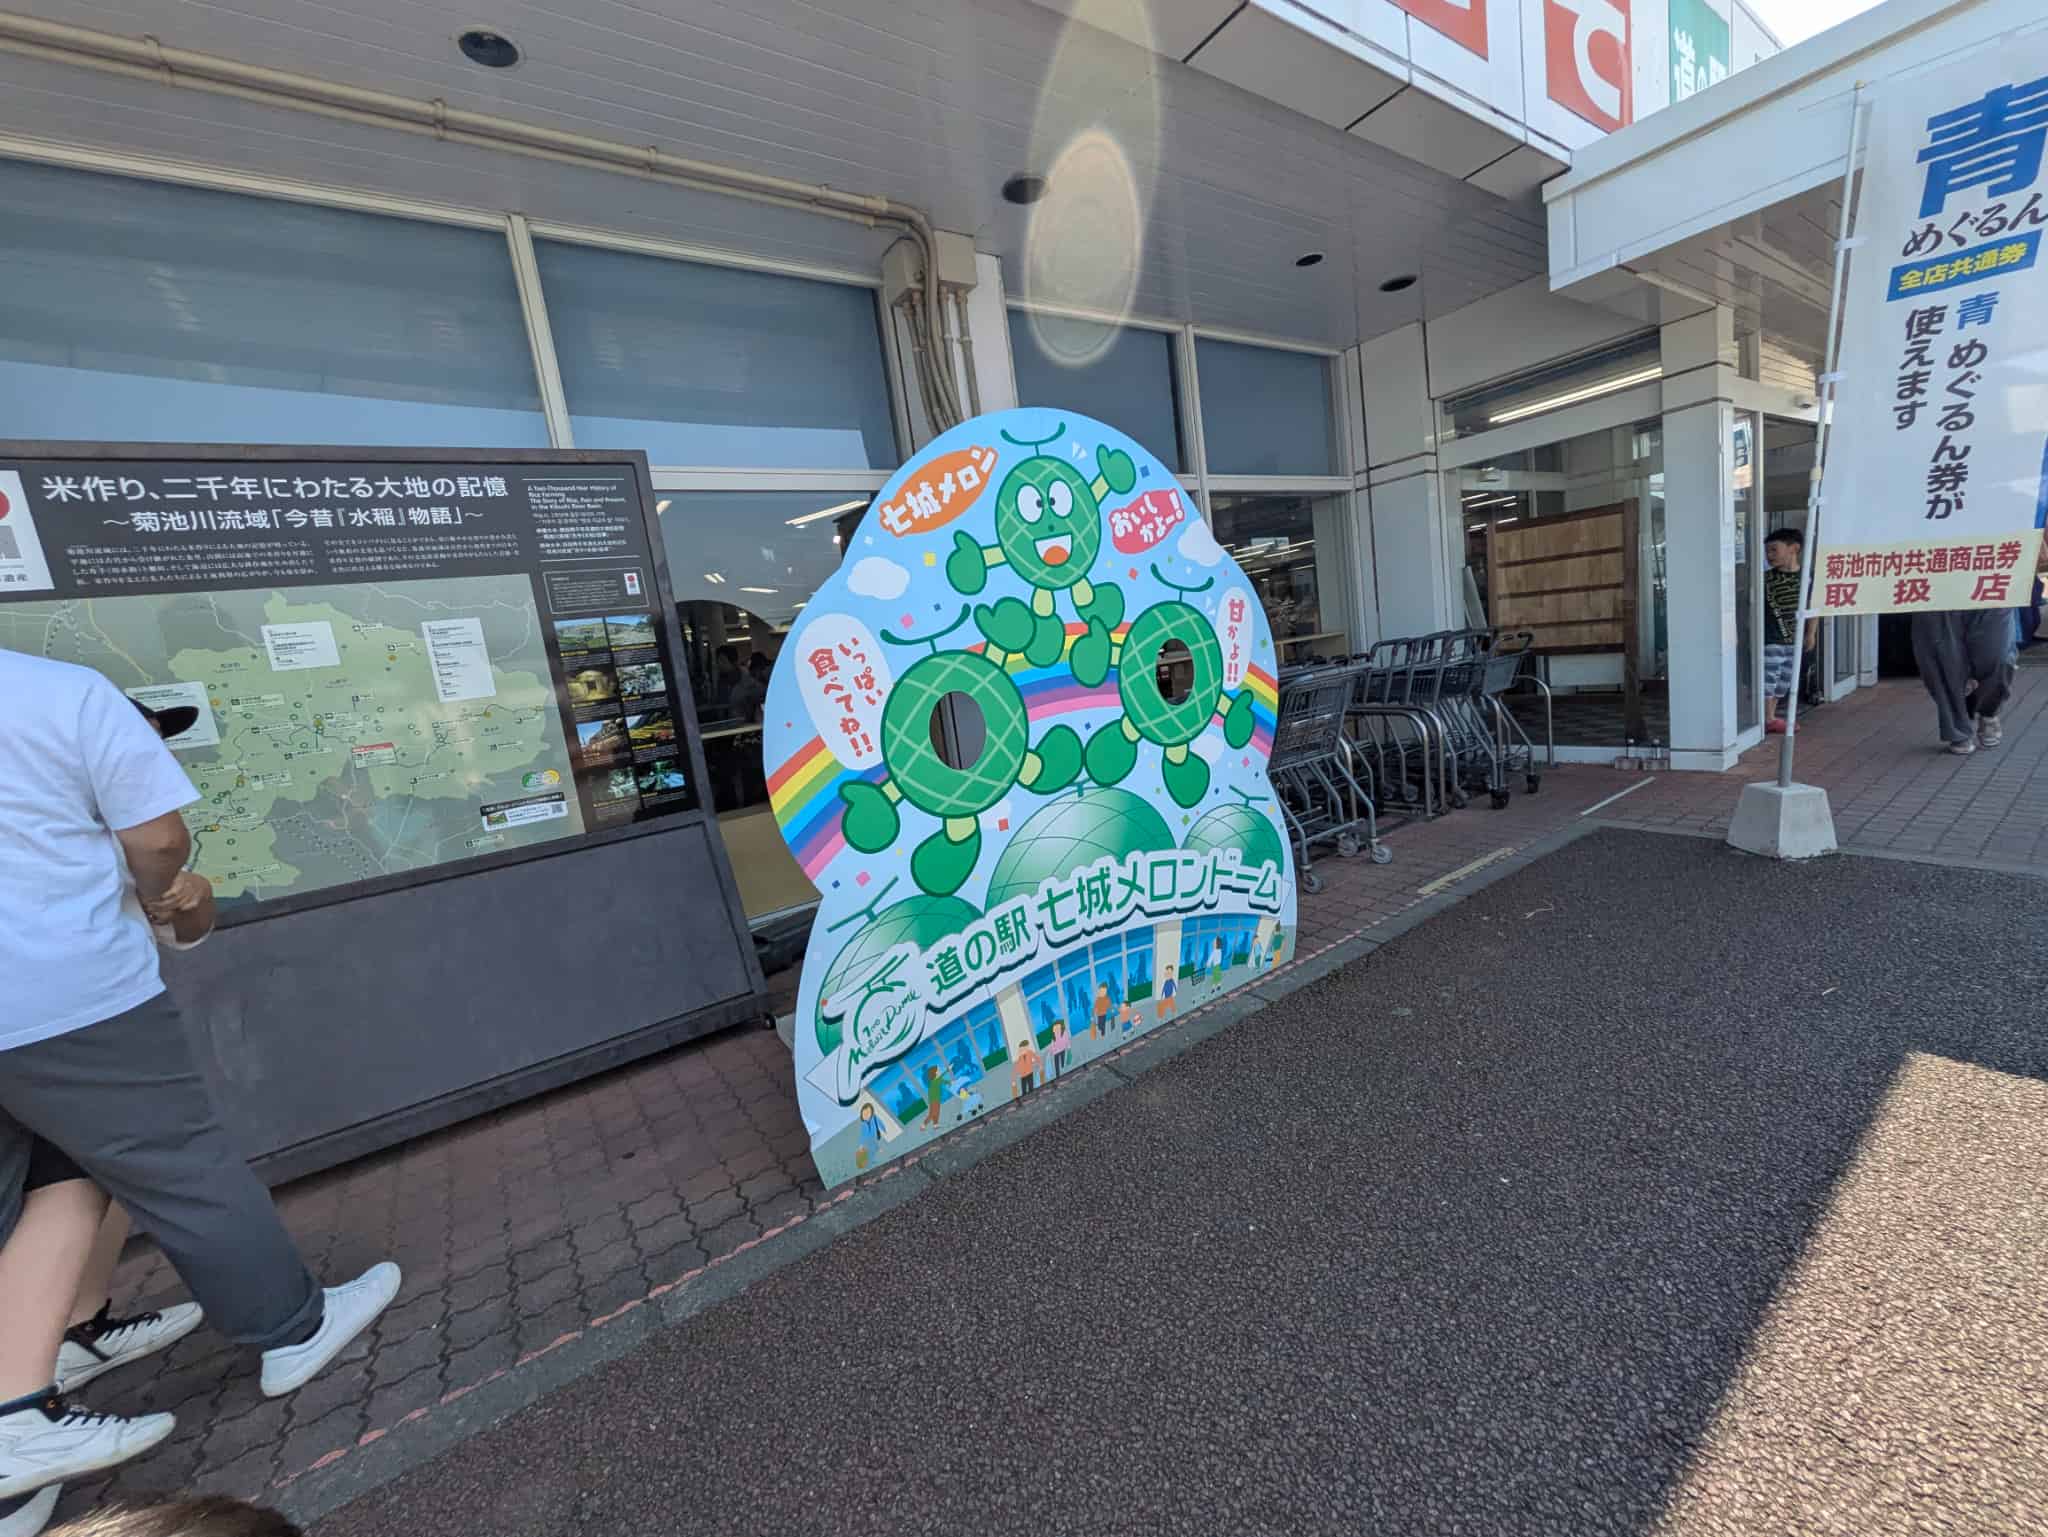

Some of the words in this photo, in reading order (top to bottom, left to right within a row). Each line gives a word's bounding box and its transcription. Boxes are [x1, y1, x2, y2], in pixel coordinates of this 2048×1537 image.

[1916, 76, 2048, 220] 青
[1902, 192, 2048, 257] めぐるん
[1898, 242, 2027, 291] 全店共通券
[1892, 304, 1948, 431] 使えます
[42, 475, 509, 503] 米作り、二千年にわたる大地の記憶
[883, 450, 996, 536] 七城メロン
[1826, 540, 2022, 580] 菊池市内共通商品券
[838, 637, 883, 706] いっぱい
[926, 904, 1032, 996] 道の駅
[1038, 855, 1281, 931] 七城メロンドーム
